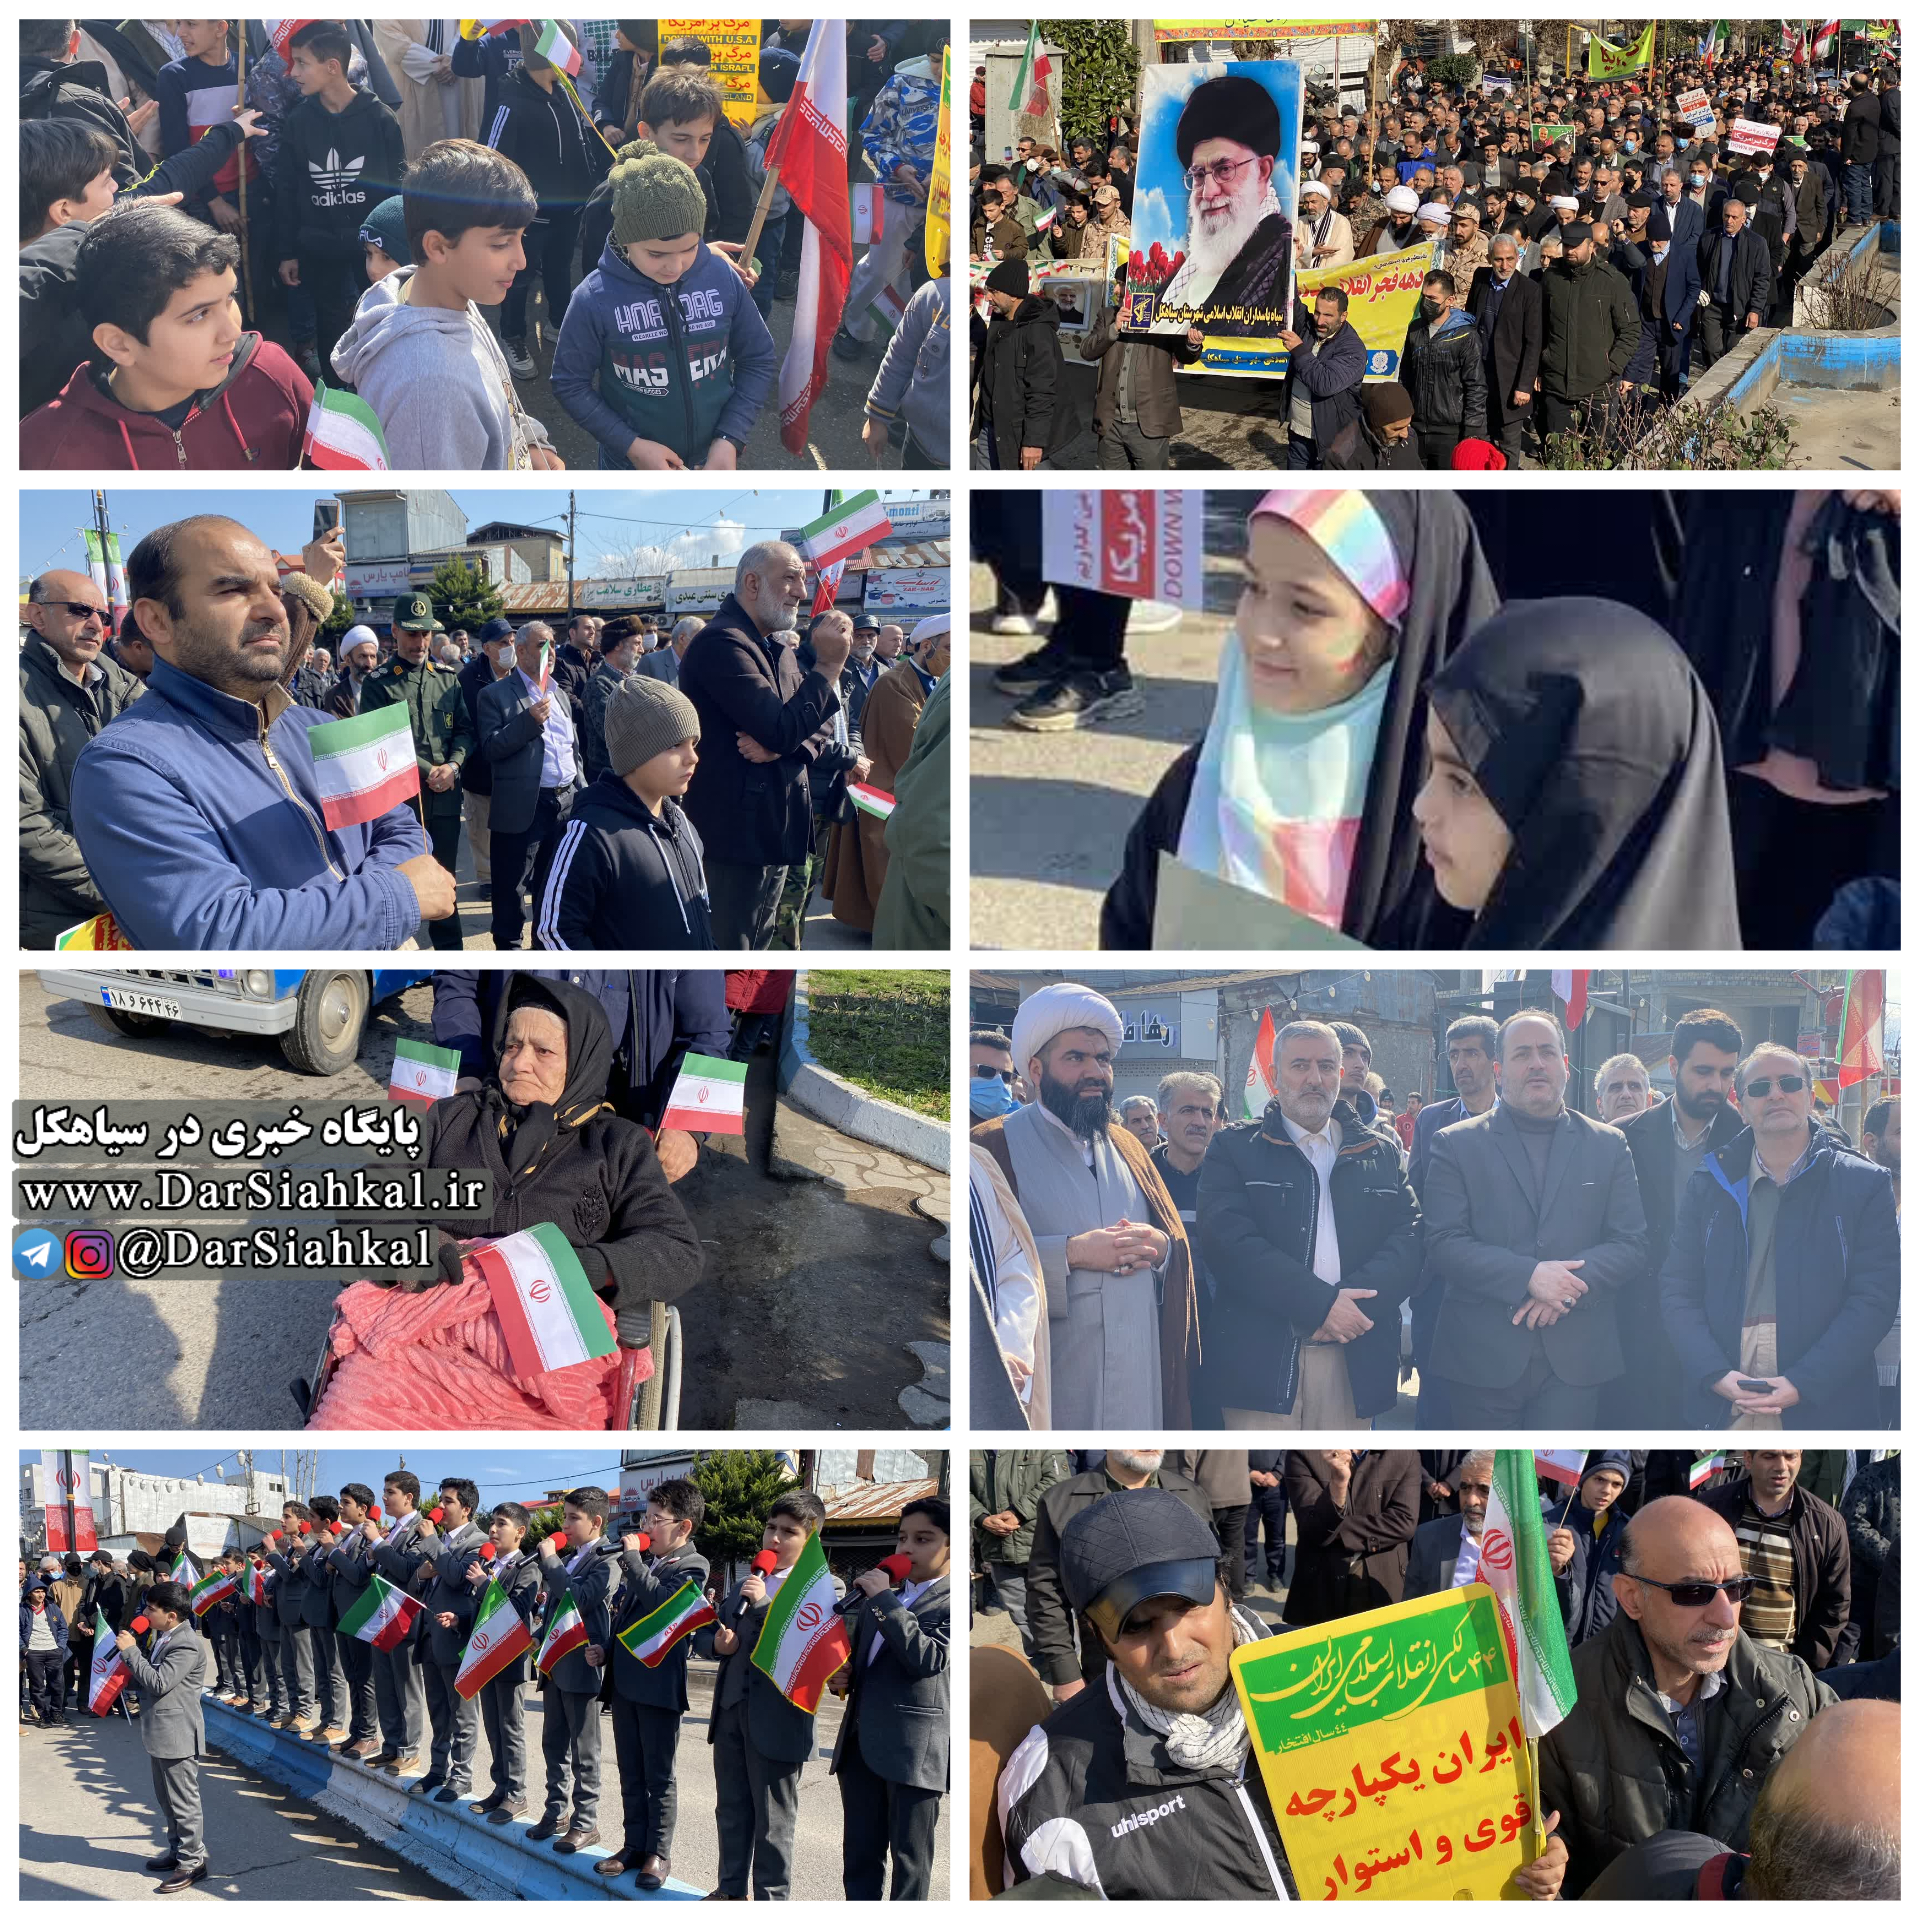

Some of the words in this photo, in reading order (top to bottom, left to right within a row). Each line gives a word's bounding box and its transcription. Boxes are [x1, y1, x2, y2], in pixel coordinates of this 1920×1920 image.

[726, 35, 753, 45] U.S.A
[726, 46, 752, 62] مرگ
[720, 63, 752, 72] ISRAEL
[725, 76, 751, 91] مرگ
[311, 190, 366, 207] adidas
[1368, 266, 1399, 302] فجر
[1397, 269, 1424, 291] دهه
[1155, 302, 1178, 322] سیاهکل
[1177, 303, 1204, 323] شهرستان
[1203, 304, 1226, 323] اسلامی
[1225, 305, 1244, 323] انقلاب
[1243, 306, 1270, 326] پاسداران
[1270, 306, 1283, 327] سپاه
[1164, 513, 1182, 598] DOWN
[363, 566, 388, 584] پارس
[596, 583, 622, 596] سلامت
[624, 582, 652, 597] عطاری
[675, 592, 697, 604] عبدی
[697, 589, 717, 604] سنتی
[1250, 1635, 1342, 1702] ایران
[1468, 1646, 1497, 1678] ۴۴
[1290, 1636, 1393, 1719] اسلامی
[1346, 1639, 1437, 1708] انقلاب
[1276, 1733, 1313, 1756] افتخار
[1312, 1727, 1336, 1744] سال
[1432, 1715, 1522, 1785] ایران
[1285, 1751, 1426, 1822] یکپارچه
[1111, 1795, 1186, 1838] uhlsport
[1464, 1792, 1532, 1852] قوی
[1436, 1834, 1454, 1866] و
[1323, 1829, 1424, 1900] استوار
